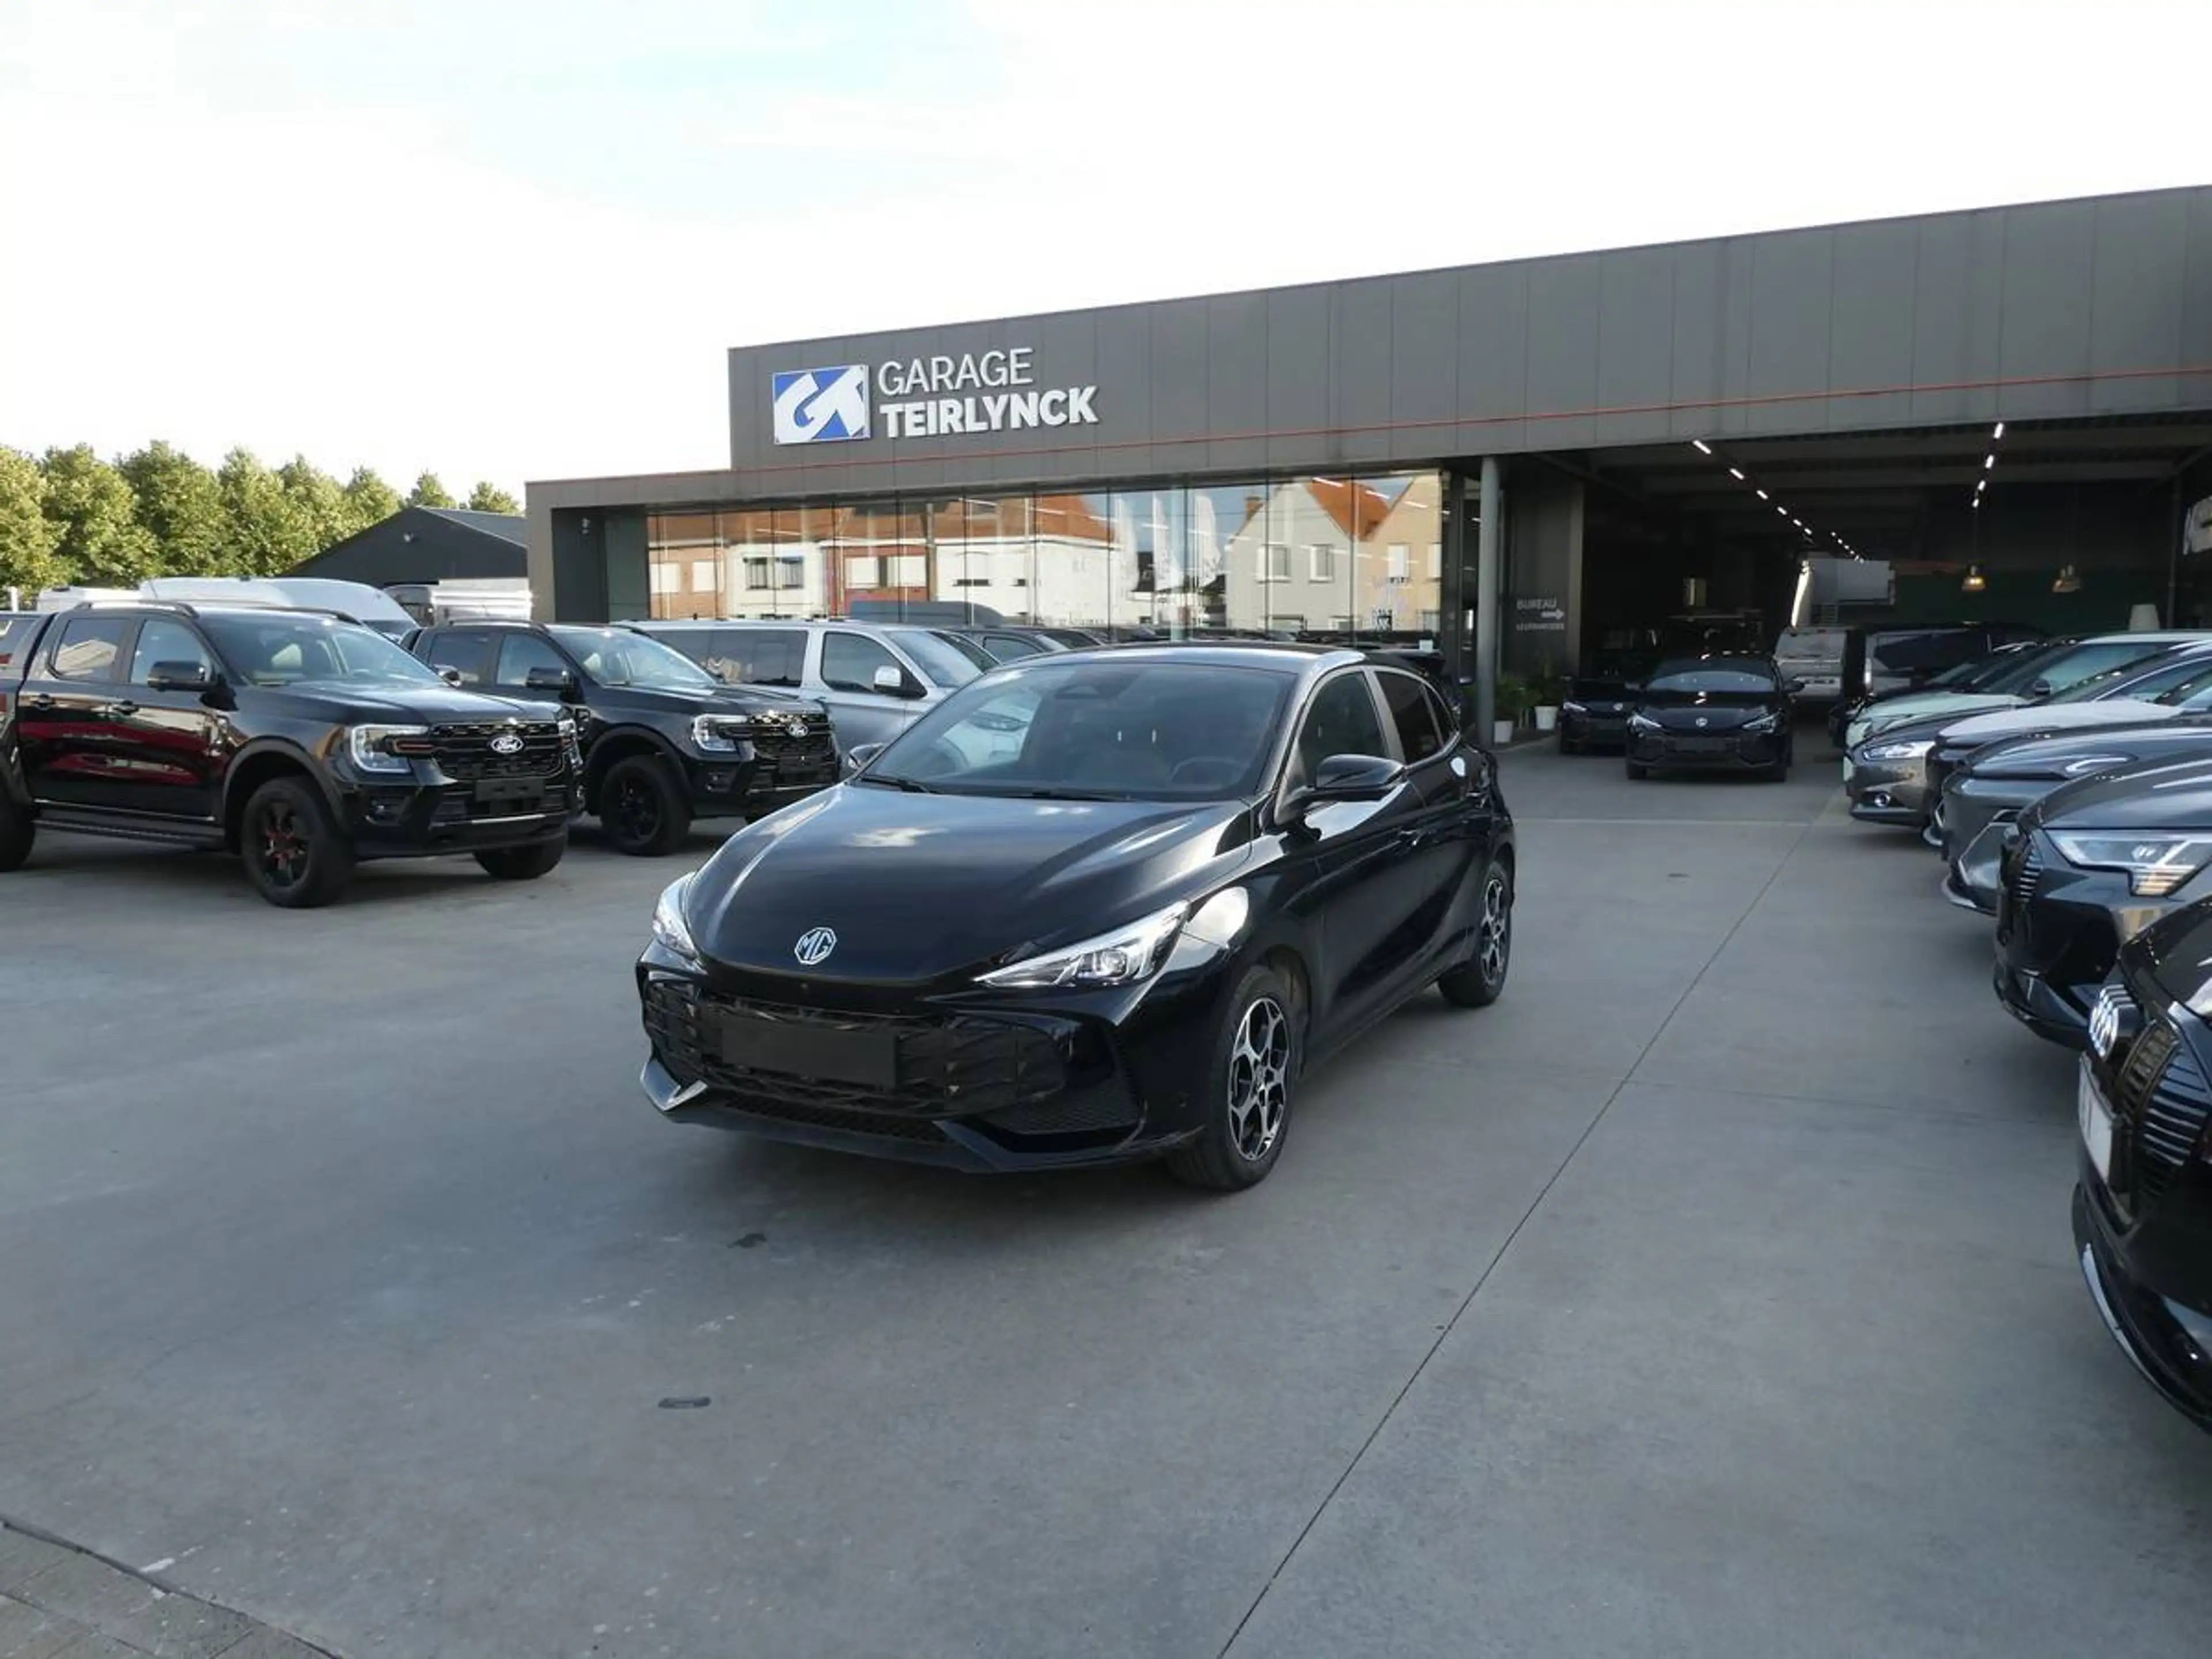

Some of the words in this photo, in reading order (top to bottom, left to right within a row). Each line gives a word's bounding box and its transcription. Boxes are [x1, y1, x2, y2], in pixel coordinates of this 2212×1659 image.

[878, 347, 1034, 396] GARAGE
[879, 385, 1098, 438] TEIRLYNCK
[1517, 597, 1557, 610] BUREAU
[798, 930, 832, 960] MG
